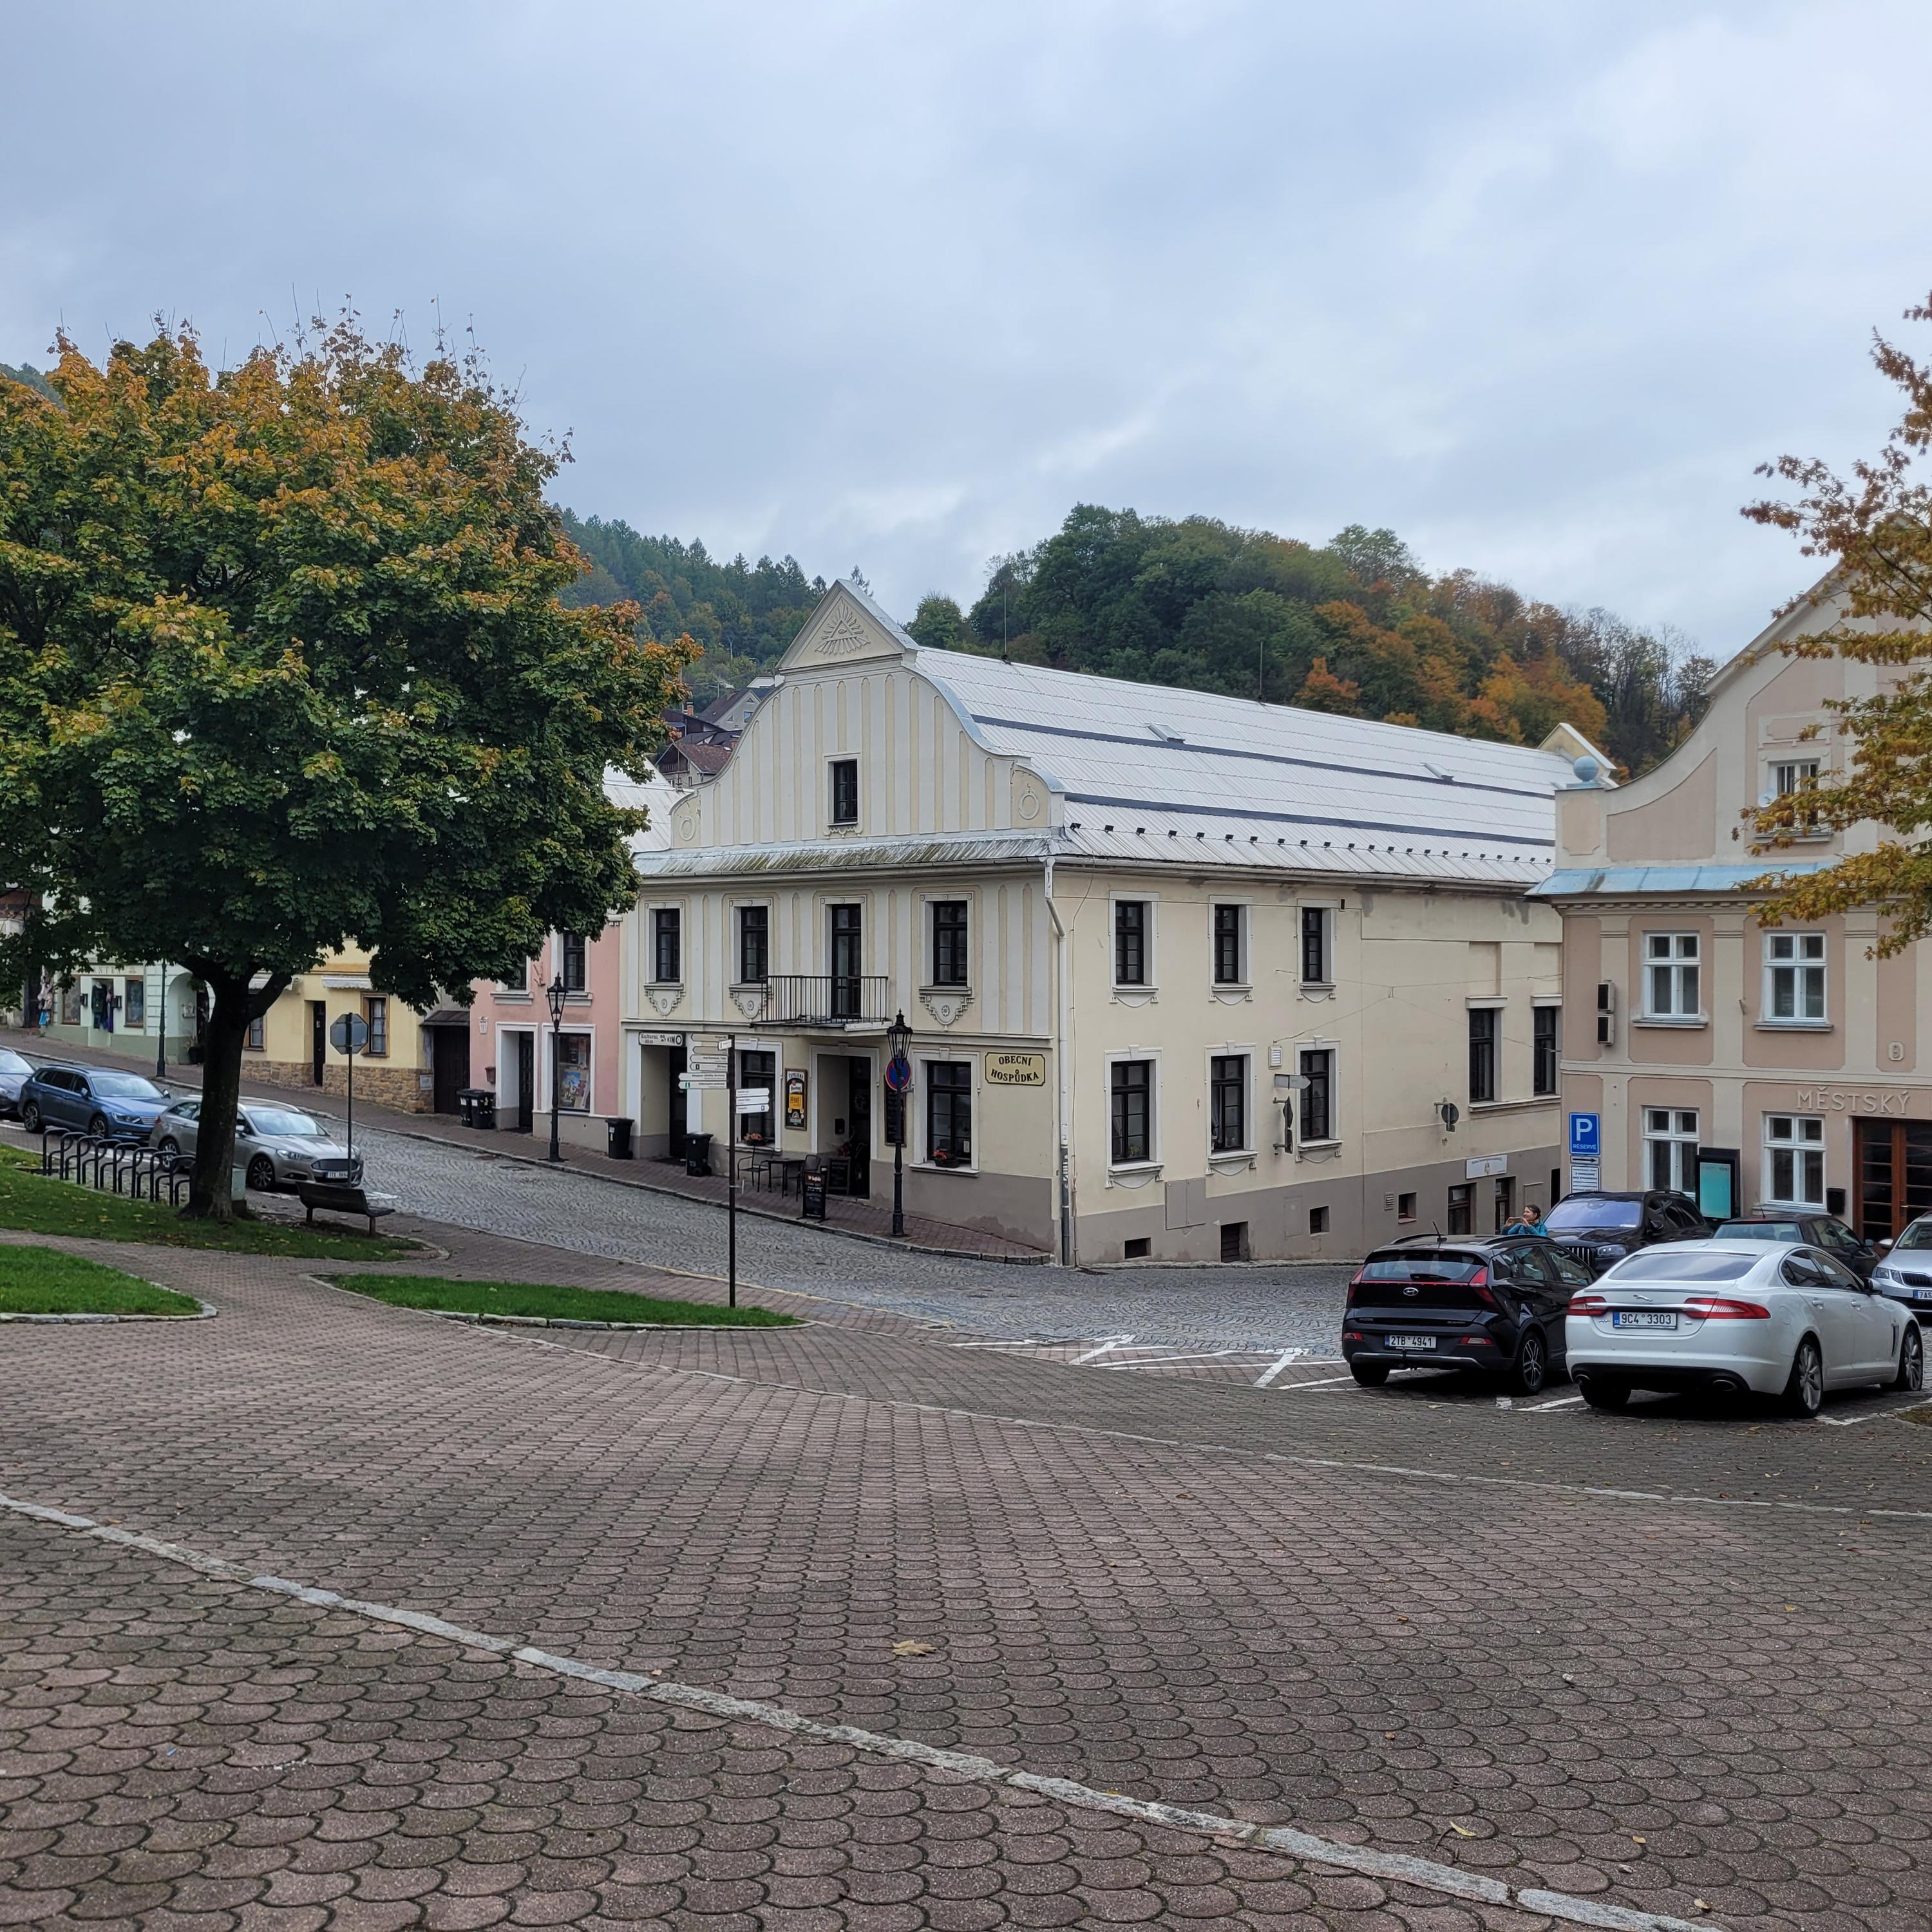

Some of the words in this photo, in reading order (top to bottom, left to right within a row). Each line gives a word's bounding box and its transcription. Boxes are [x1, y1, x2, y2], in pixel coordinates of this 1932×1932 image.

[667, 1035, 682, 1045] KINO
[990, 1068, 1039, 1083] HOSPŮDKA
[1796, 1086, 1911, 1114] MĚSTSKÝ
[1576, 1118, 1593, 1141] P
[1621, 1313, 1640, 1324] 9C4
[1647, 1314, 1672, 1325] 3303
[1391, 1336, 1406, 1346] 2TB
[1412, 1336, 1432, 1347] 4941
